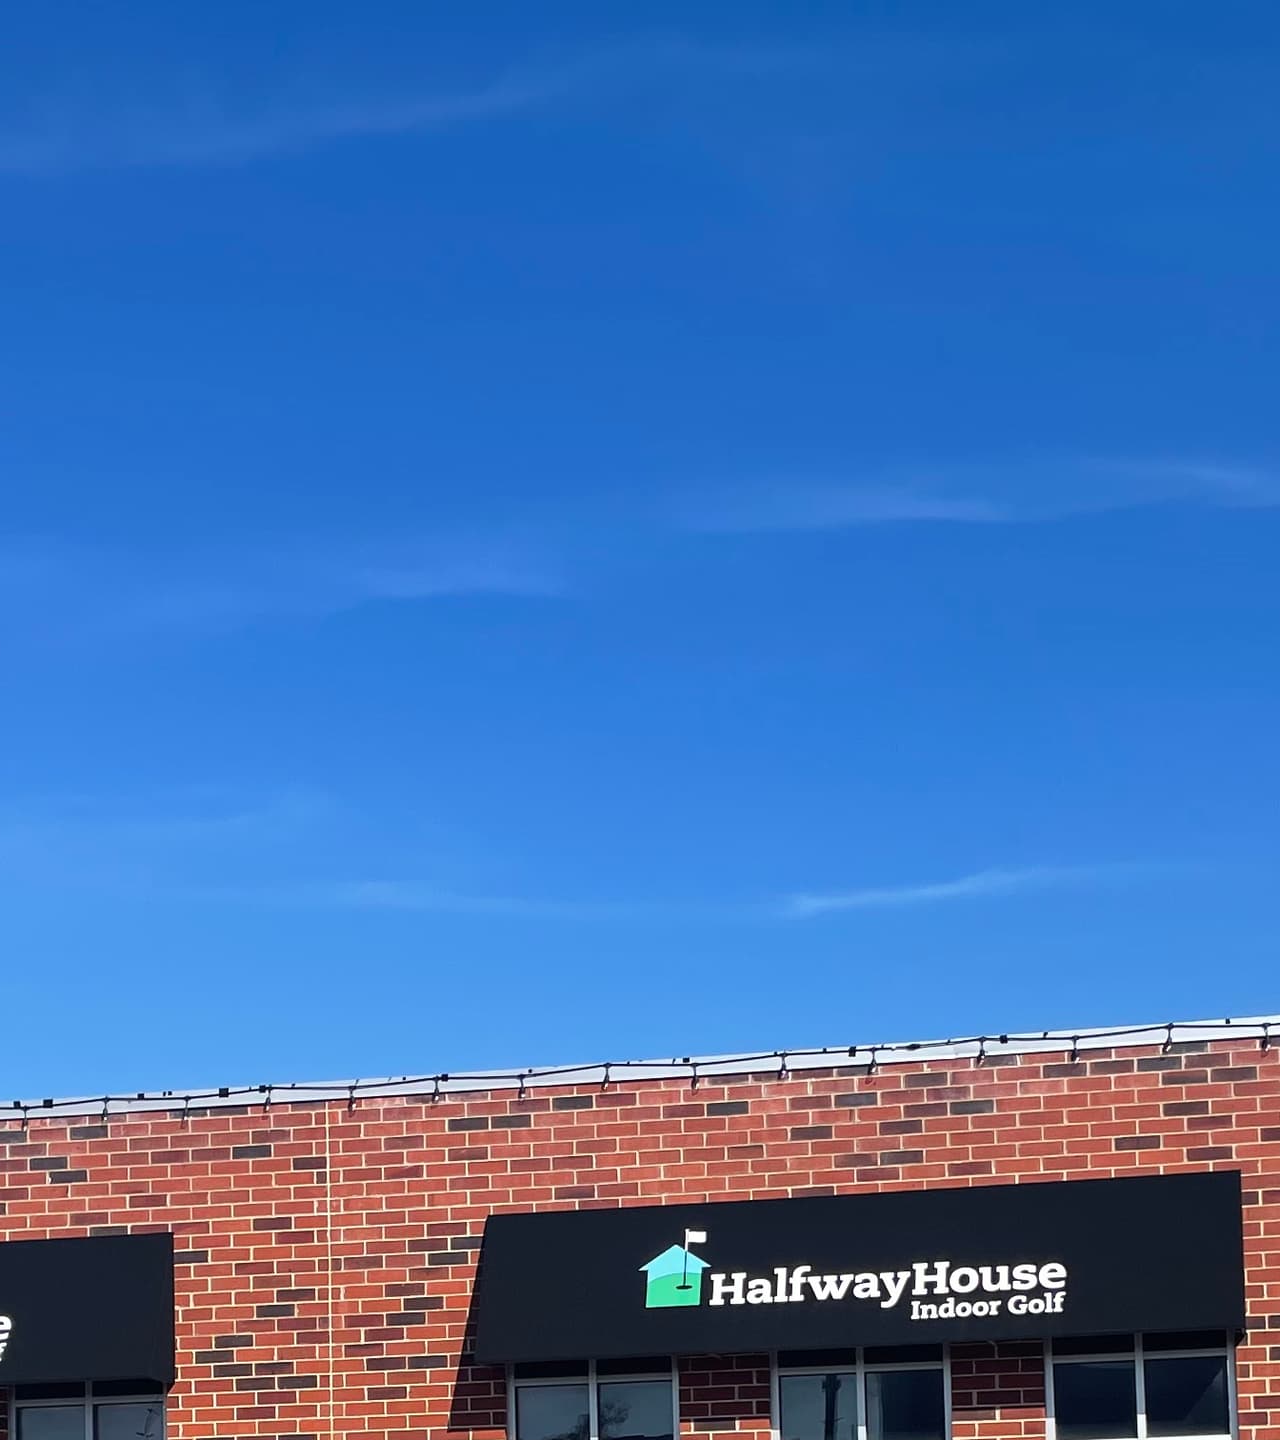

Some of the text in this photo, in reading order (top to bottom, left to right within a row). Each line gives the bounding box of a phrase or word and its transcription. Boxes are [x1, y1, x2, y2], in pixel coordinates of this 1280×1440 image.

[708, 1261, 1067, 1308] HalfwayHouse
[910, 1292, 1066, 1320] Indoor Golf
